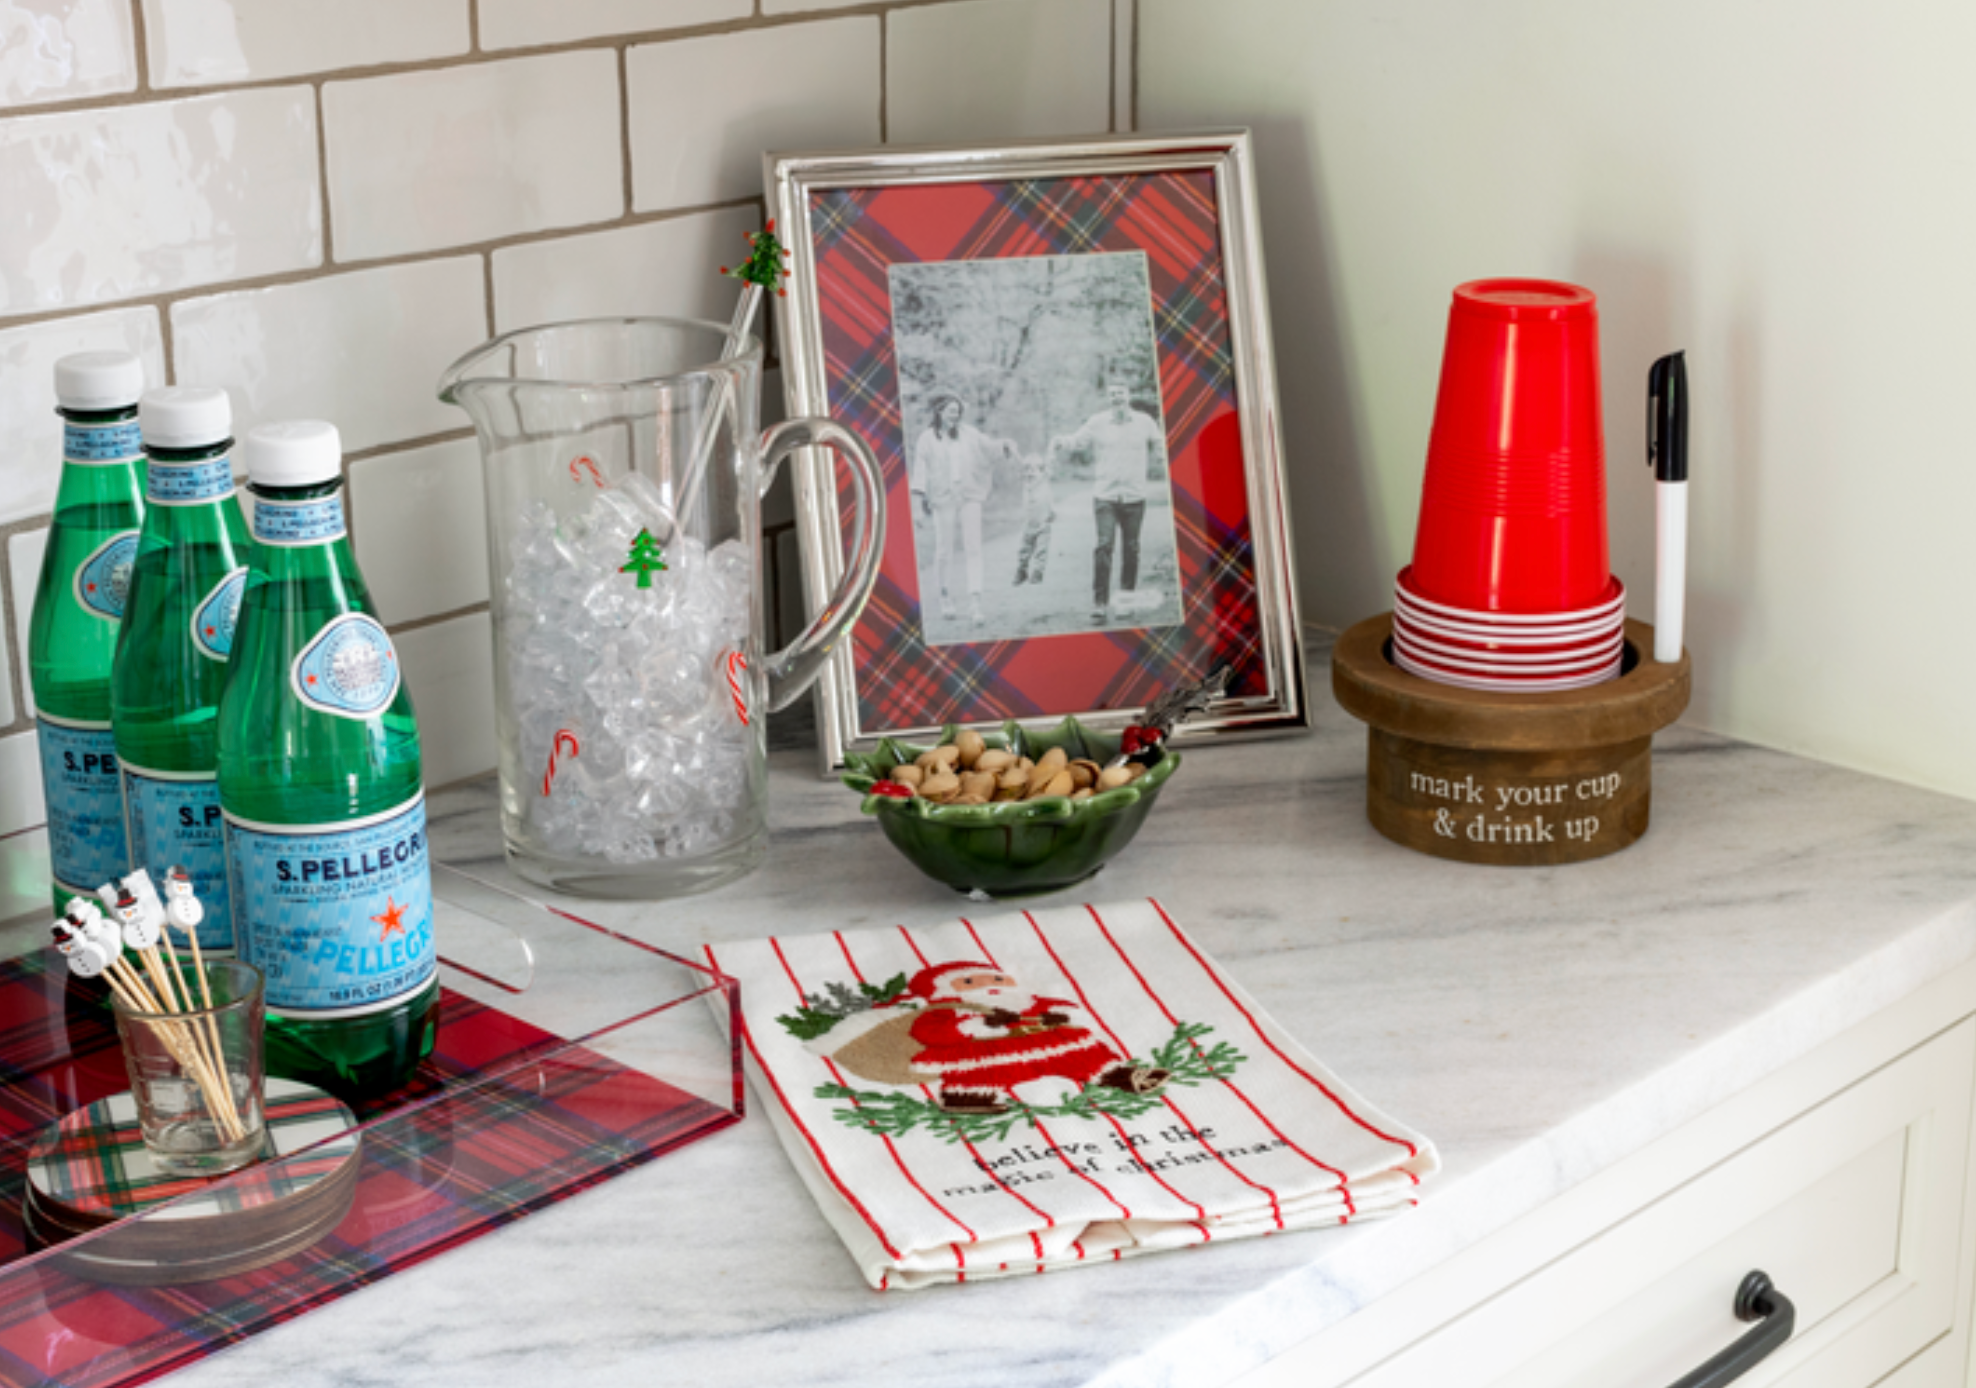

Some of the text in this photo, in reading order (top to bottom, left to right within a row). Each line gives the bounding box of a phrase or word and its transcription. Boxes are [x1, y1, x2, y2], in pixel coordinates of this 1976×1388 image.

[1410, 771, 1621, 811] mark your cup
[1433, 807, 1600, 842] & drink up
[943, 1138, 1290, 1197] magic of christmas
[973, 1125, 1216, 1171] believe in the
